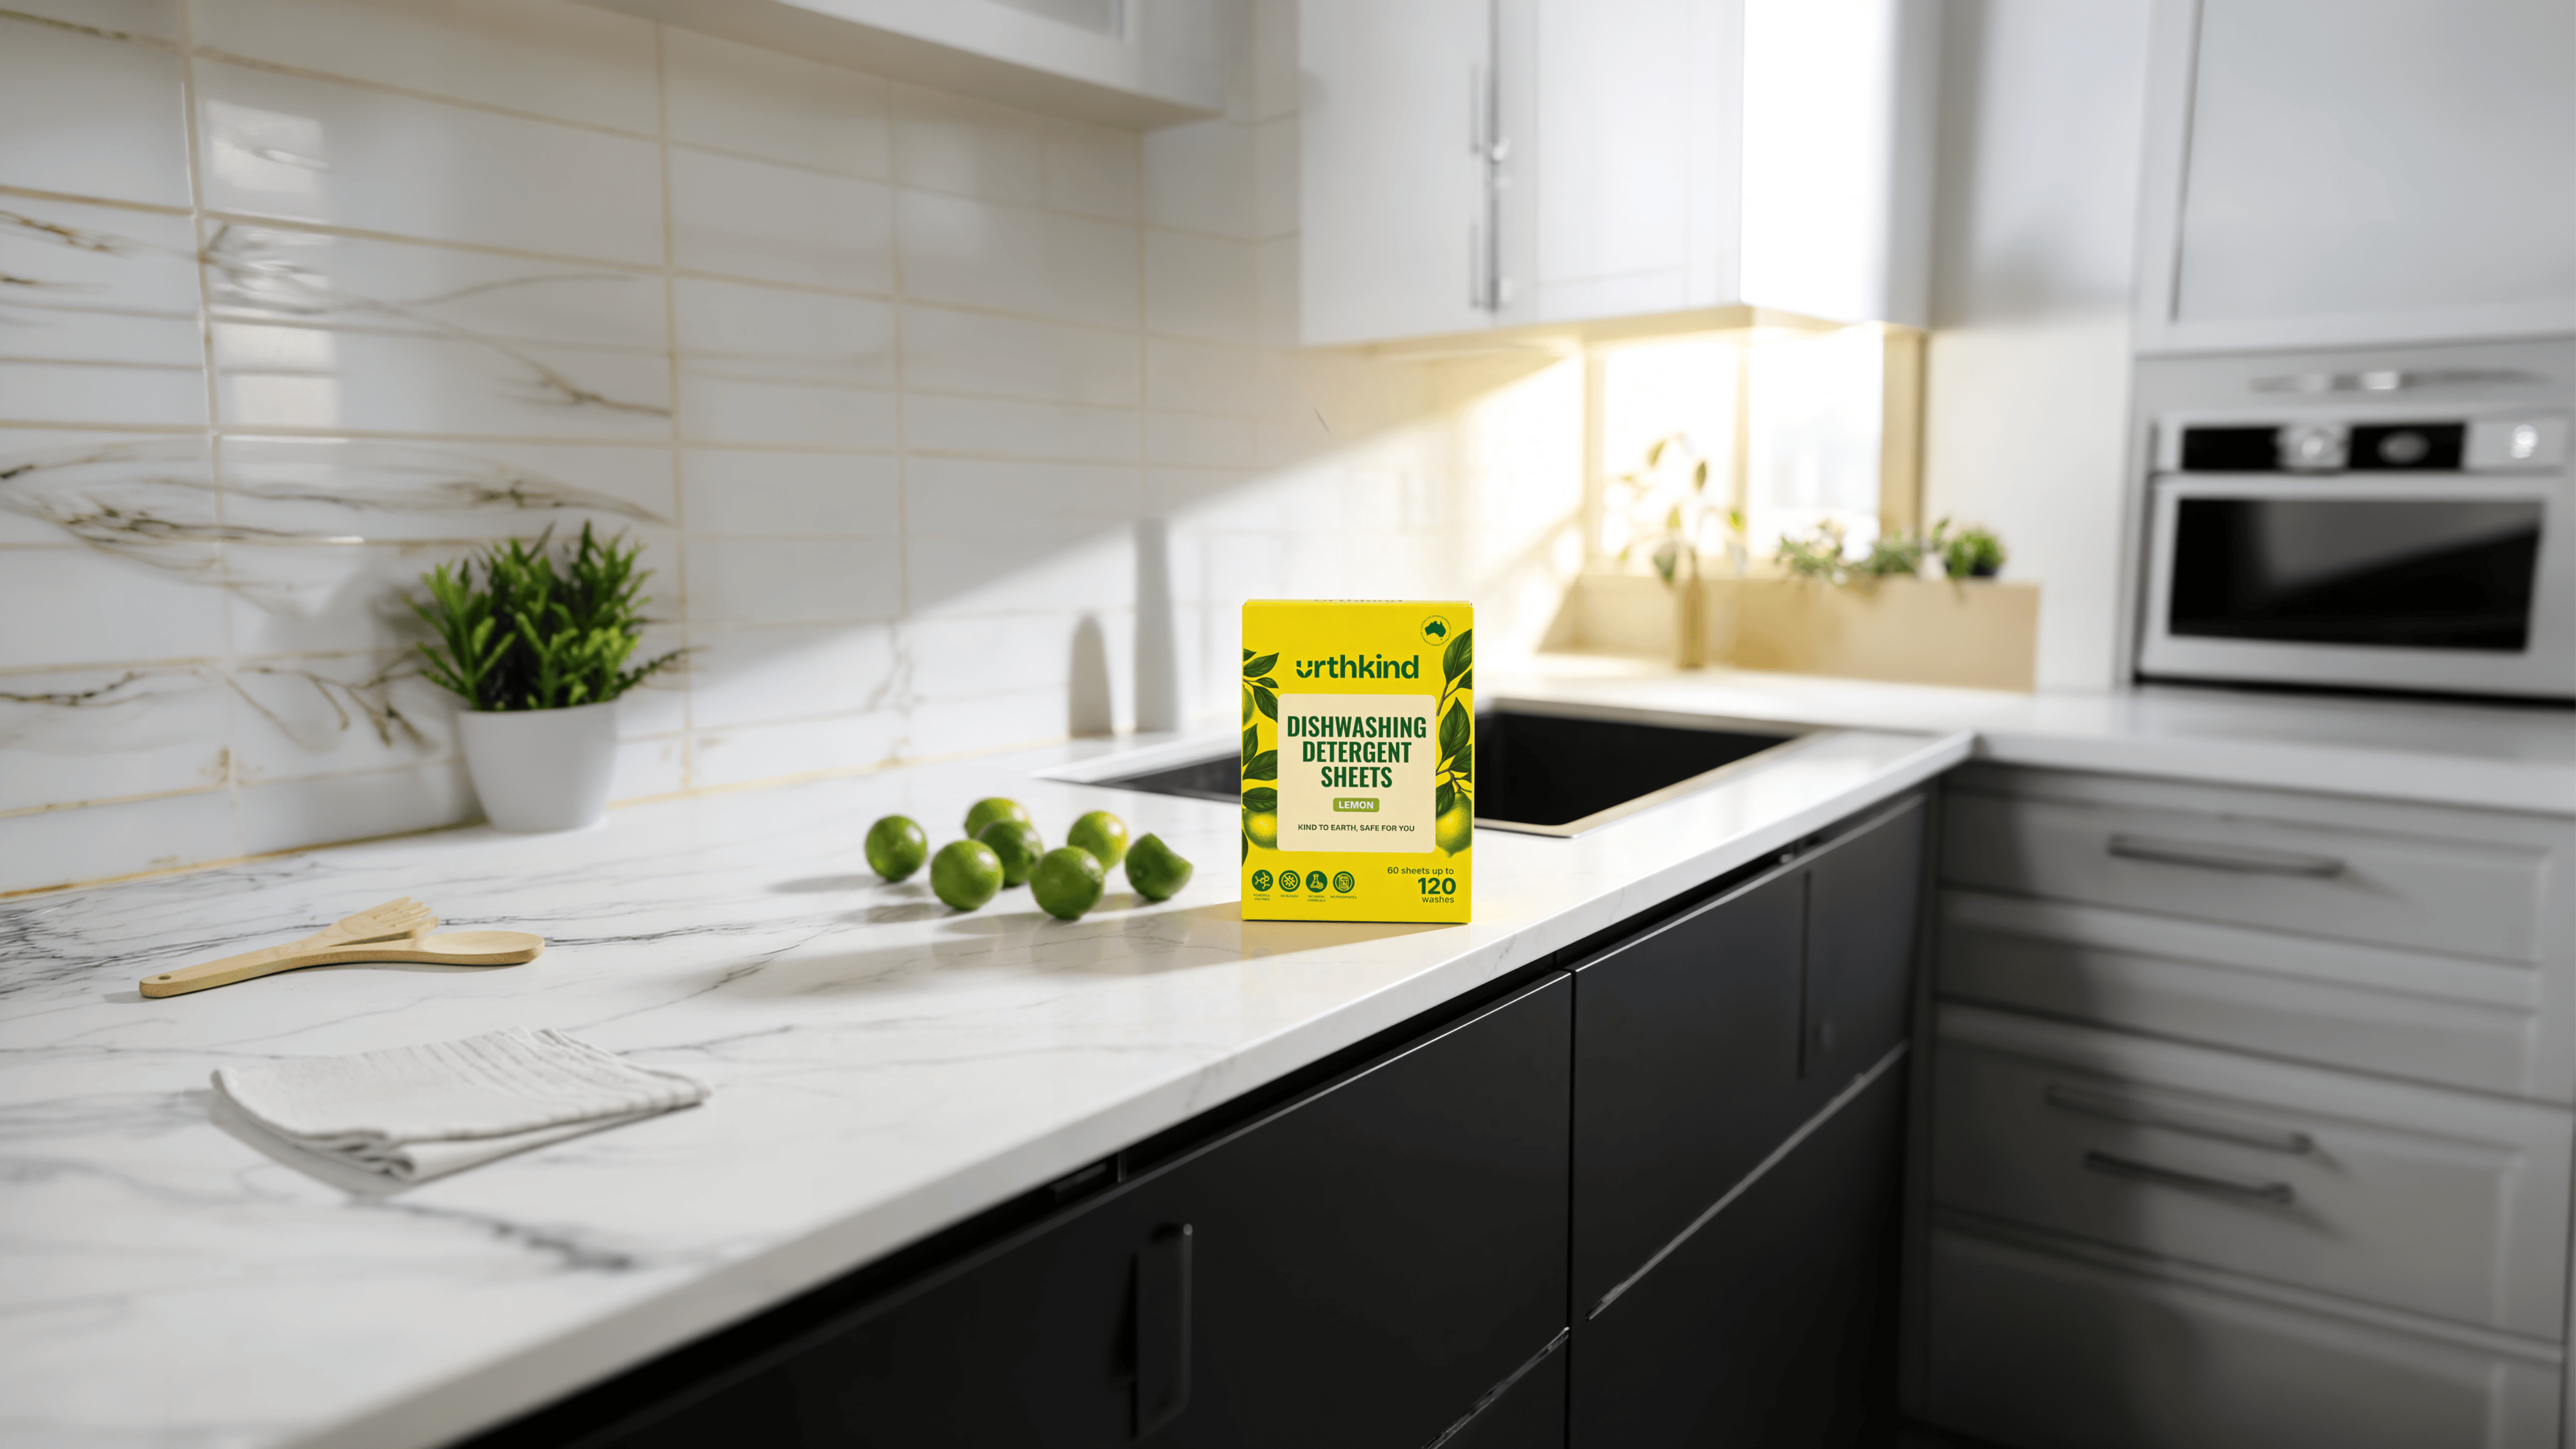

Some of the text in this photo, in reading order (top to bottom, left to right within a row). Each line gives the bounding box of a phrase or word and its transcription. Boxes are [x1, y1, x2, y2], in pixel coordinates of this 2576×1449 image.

[1296, 654, 1419, 679] urthkind
[1288, 716, 1426, 738] DISHWASHING
[1303, 741, 1411, 763] DETERGENT
[1321, 766, 1392, 788] SHEETS
[1418, 878, 1456, 895] 120
